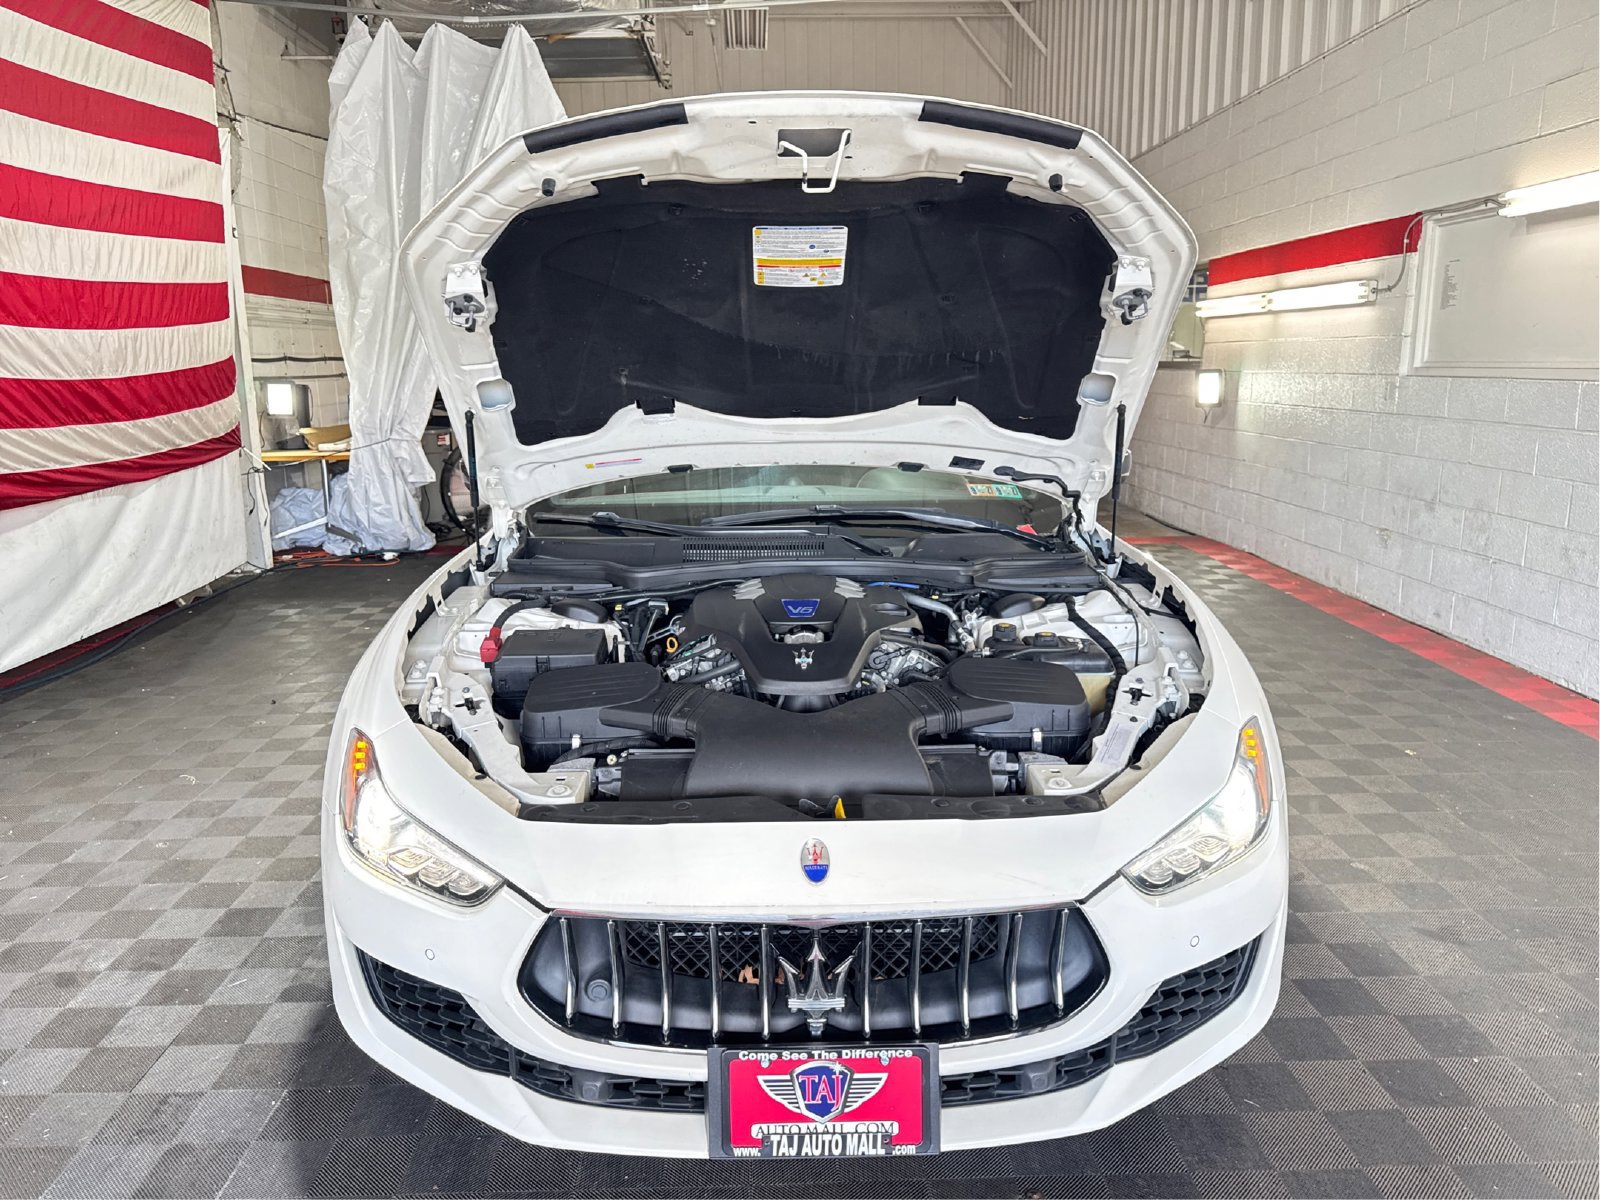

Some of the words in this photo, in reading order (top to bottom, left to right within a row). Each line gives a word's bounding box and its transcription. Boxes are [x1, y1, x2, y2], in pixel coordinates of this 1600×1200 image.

[787, 605, 814, 614] V6
[738, 1050, 778, 1060] Come
[782, 1050, 808, 1060] See
[811, 1050, 838, 1060] The
[842, 1049, 913, 1059] Difference
[800, 1075, 842, 1112] TAJ
[733, 1147, 761, 1157] www.
[770, 1135, 798, 1156] TAJ
[801, 1134, 842, 1156] AUTO
[846, 1133, 885, 1156] MALL
[892, 1145, 916, 1155] .com
